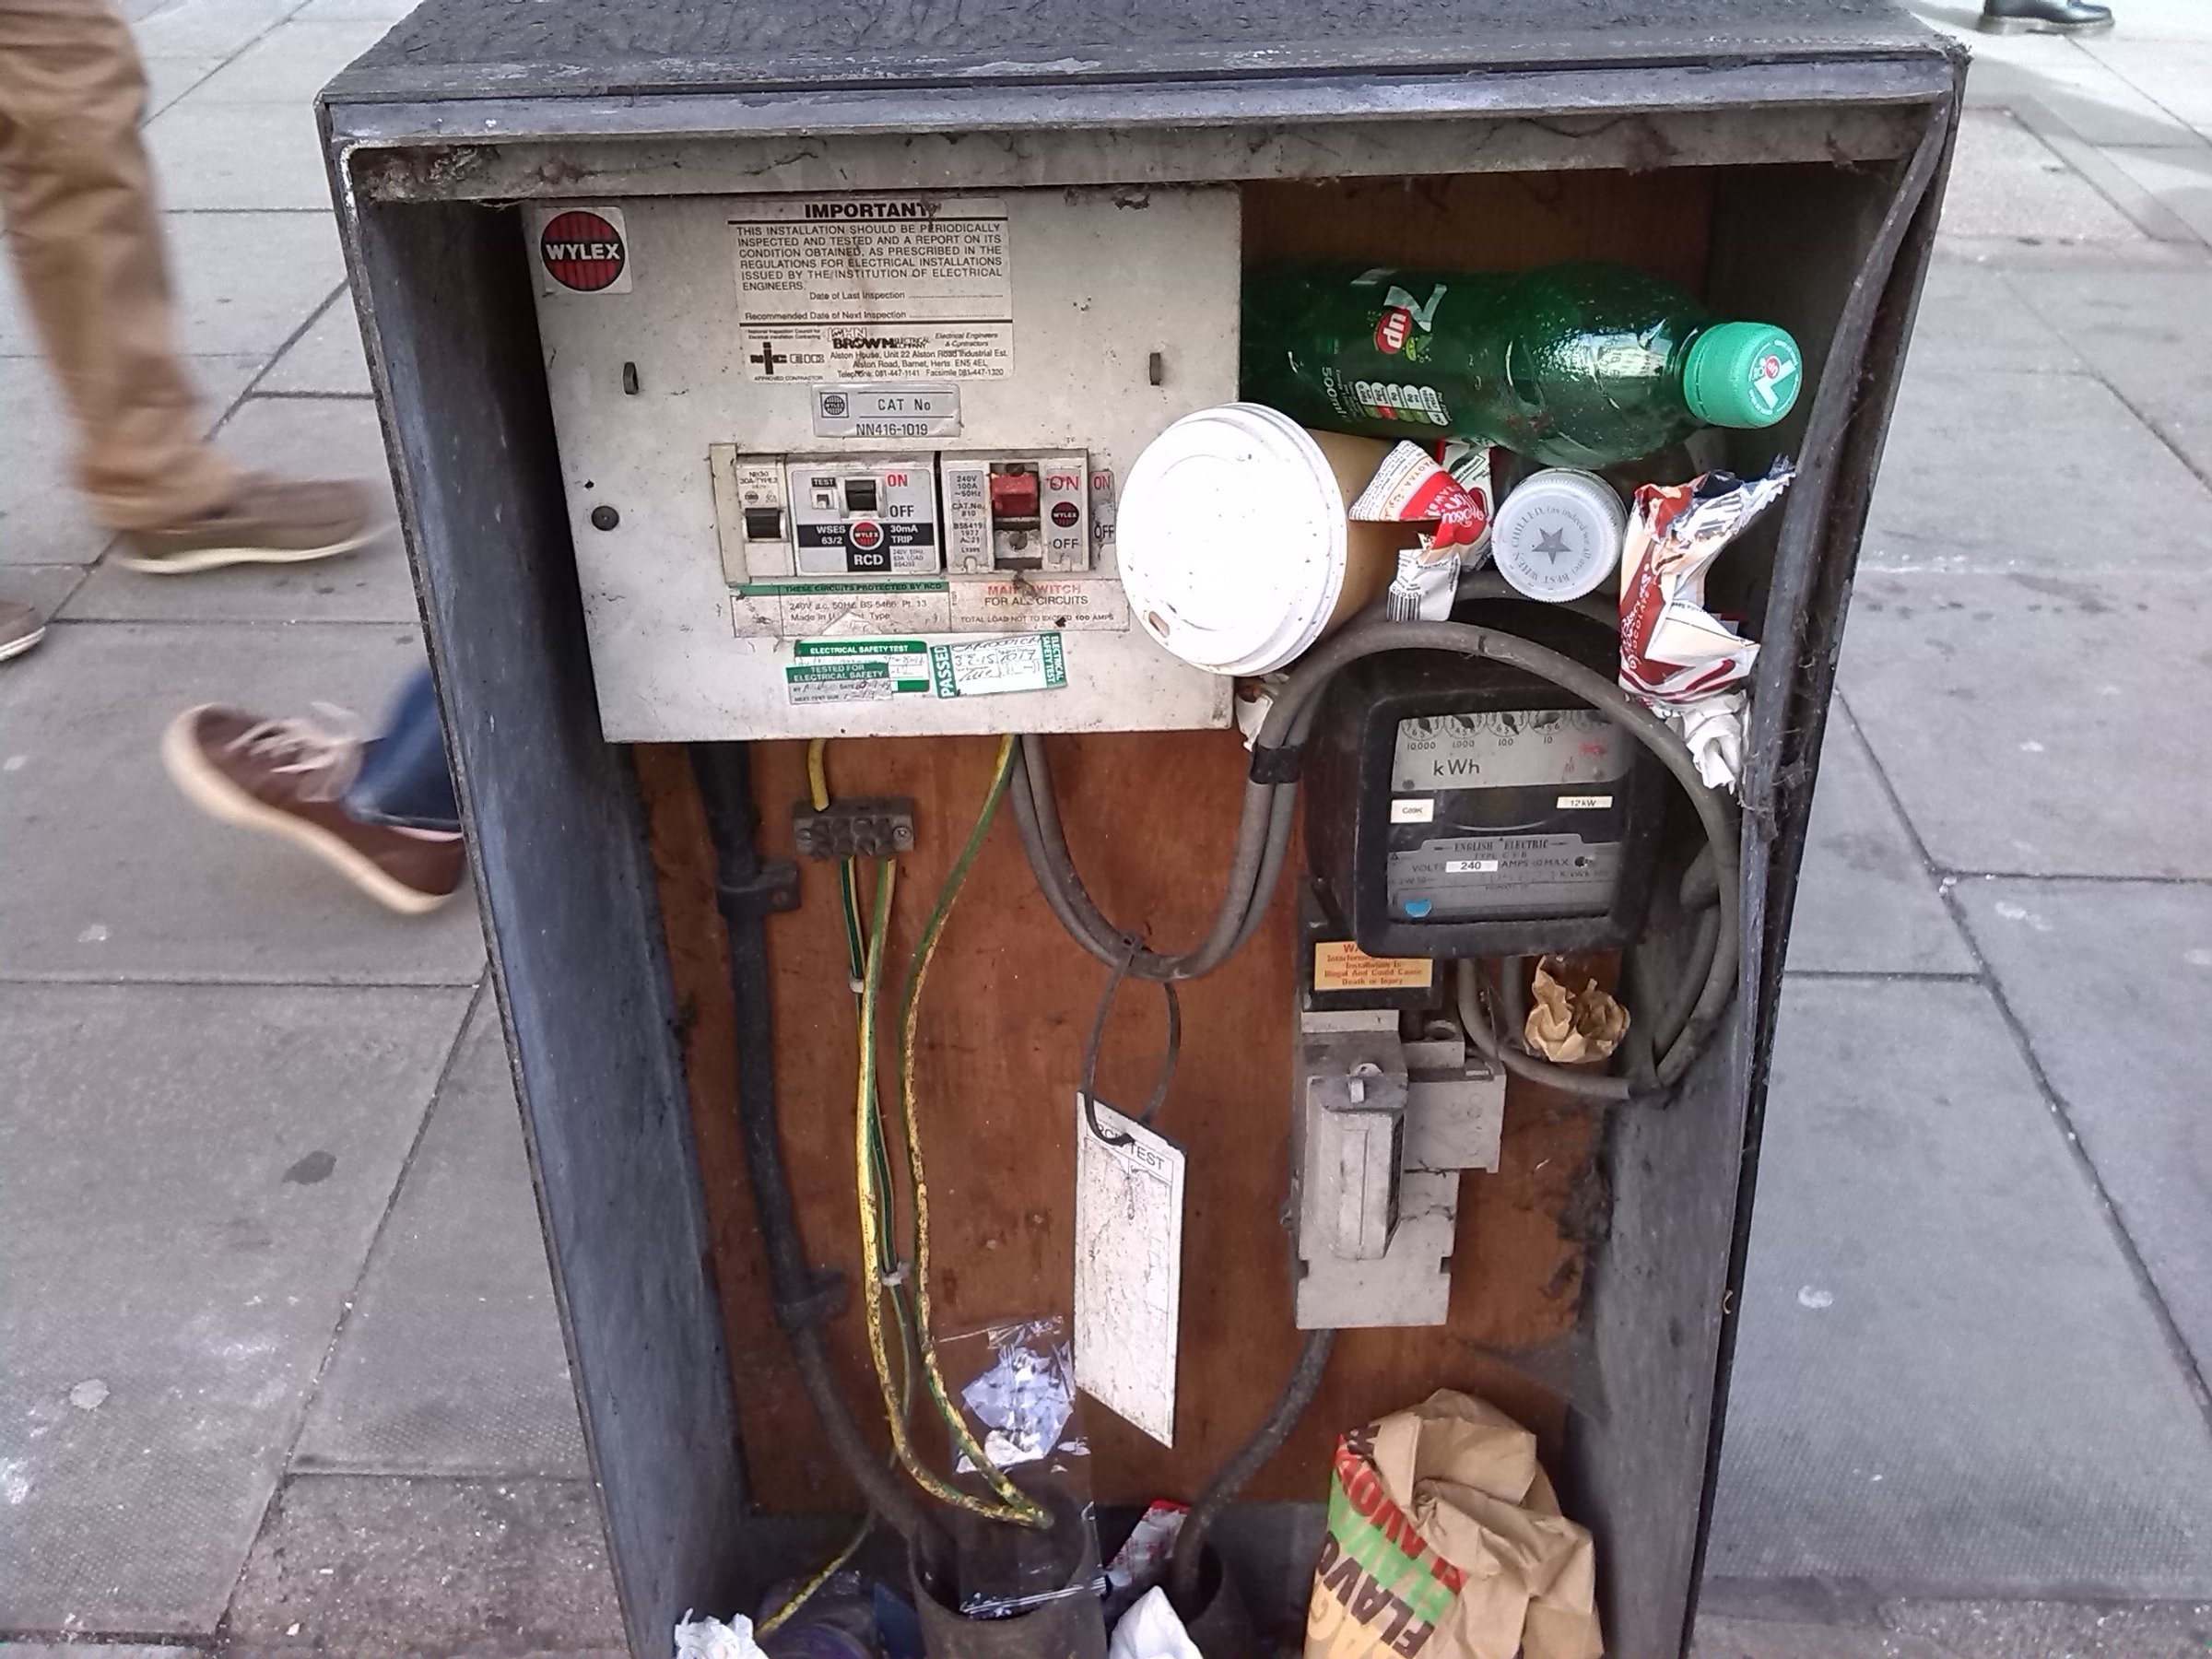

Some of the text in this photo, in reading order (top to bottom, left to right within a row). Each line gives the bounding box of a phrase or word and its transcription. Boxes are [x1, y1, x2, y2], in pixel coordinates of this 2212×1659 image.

[737, 223, 1001, 236] THIS INSTALLATION SHOULD BE PERIODICALLY
[737, 234, 1002, 247] INSPECTED AND TESTED AND A REPORT ON ITS
[546, 243, 620, 260] WYLEX
[738, 248, 801, 258] CONDITION
[868, 247, 884, 256] AS
[888, 246, 960, 256] PRESCRIBED
[964, 246, 975, 255] IN
[981, 245, 1002, 255] THE
[740, 257, 1003, 269] REGULATIONS FOR ELECTRICAL INSTALLATIONS
[742, 268, 1002, 280] ISSUED BY THE INSTITUTION OF ELECTRICAL
[809, 291, 905, 300] Date of Last Inspection
[745, 312, 807, 321] Recommended
[810, 312, 830, 320] Date
[841, 312, 862, 320] Next
[864, 311, 906, 320] Inspection
[937, 349, 958, 358] Road
[878, 360, 900, 369] Road,
[901, 359, 929, 369] Barnet,
[955, 359, 971, 367] EN5
[926, 369, 957, 377] Facsimile
[1322, 367, 1347, 415] 500ml
[877, 398, 931, 411] CAT No
[856, 423, 928, 436] NN416-1019
[887, 474, 908, 487] ON
[1050, 476, 1078, 490] ON
[1093, 476, 1111, 490] ON
[889, 505, 914, 517] OFF
[817, 525, 846, 534] WSES
[889, 524, 918, 533] 30mA
[1094, 524, 1114, 539] OFF
[821, 536, 842, 545] 63/2
[1053, 538, 1079, 549] OFF
[853, 554, 884, 565] RCD
[1512, 551, 1539, 582] WHEN
[1543, 571, 1571, 584] BEST
[856, 583, 906, 592] PROTECTED
[984, 595, 1088, 606] FOR ALL CIRCUITS
[790, 613, 815, 622] Made
[869, 613, 890, 622] Type
[1042, 636, 1056, 683] SAFETY TEST
[1051, 636, 1065, 681] ELECTRICAL
[810, 665, 845, 673] TESTED
[934, 645, 955, 698] PASSED
[794, 673, 848, 682] ELECTRICAL
[849, 670, 884, 678] SAFETY
[1453, 740, 1475, 748] 1000
[1498, 738, 1514, 747] 100
[1543, 735, 1553, 744] 10
[1433, 759, 1480, 775] kWh
[1454, 839, 1548, 852] ENGLISH ELECTRIC
[1460, 862, 1482, 870] 240
[1501, 859, 1528, 867] AMPS
[1545, 858, 1569, 866] MAX
[1346, 961, 1390, 970] Installation
[1380, 977, 1404, 985] Injury
[1130, 1142, 1165, 1171] TEST
